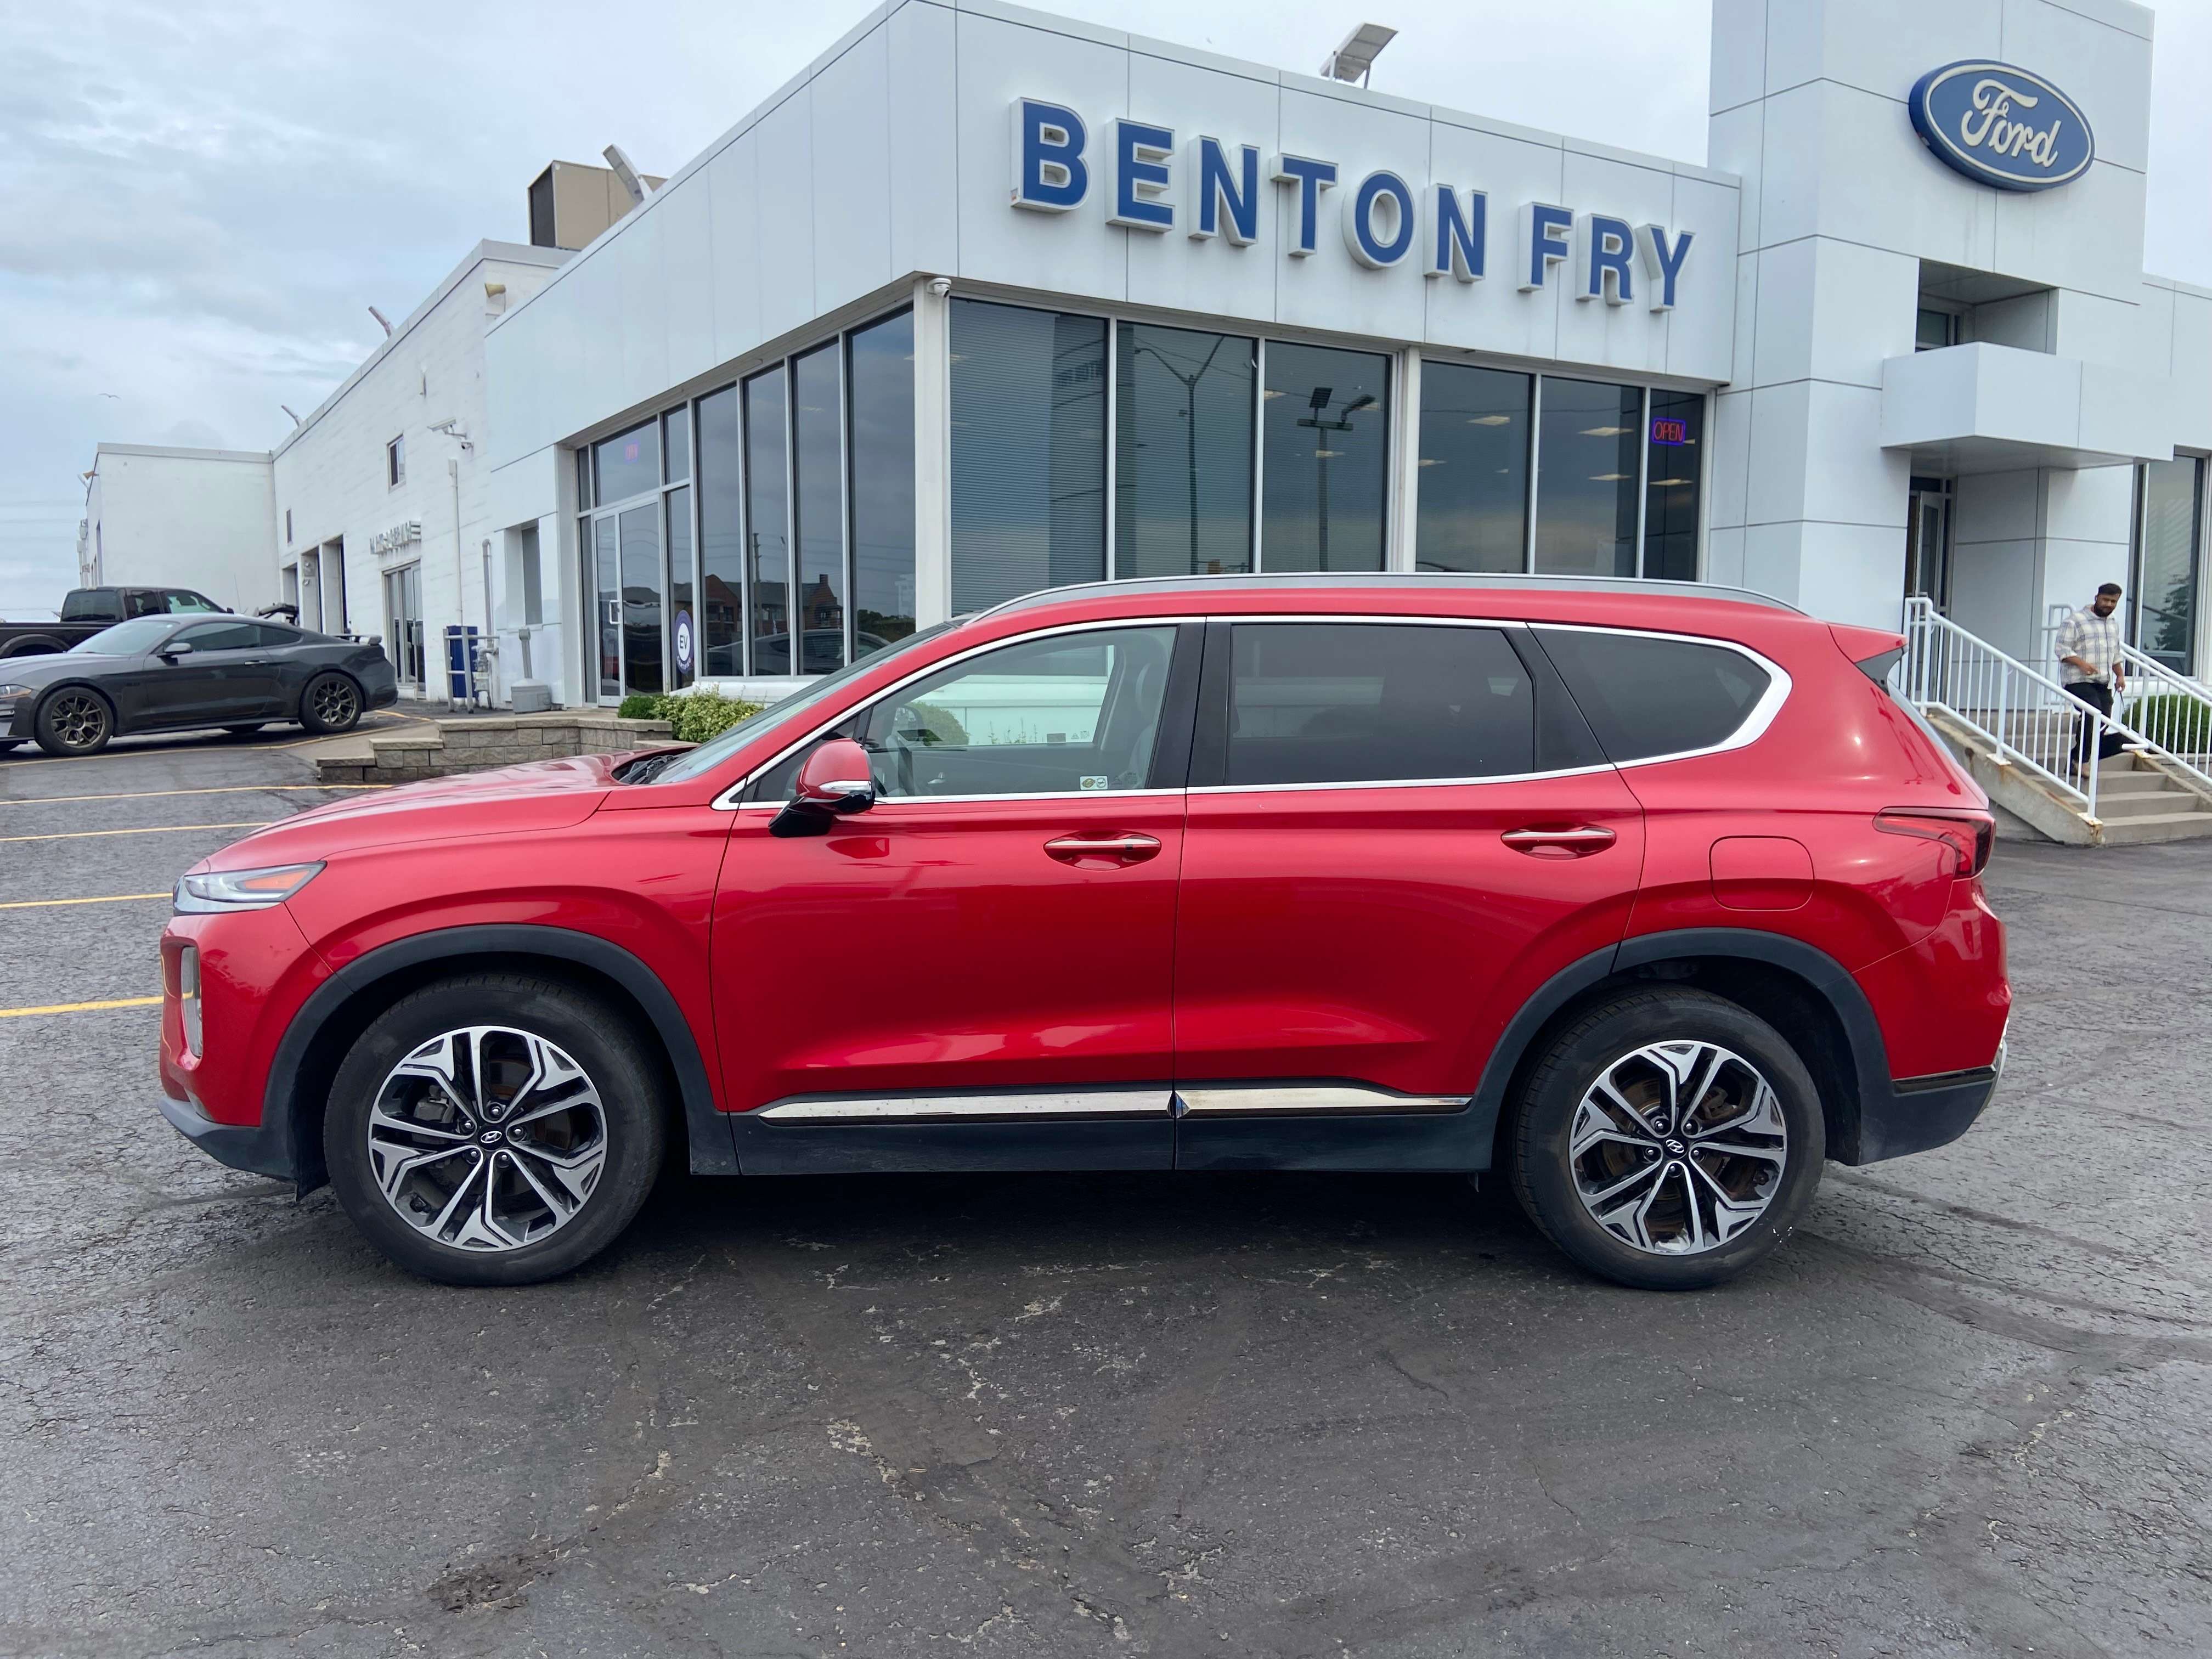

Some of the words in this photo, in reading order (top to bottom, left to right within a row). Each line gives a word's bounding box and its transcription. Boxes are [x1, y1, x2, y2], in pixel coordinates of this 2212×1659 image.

[1960, 78, 2062, 168] Ford
[1012, 98, 1488, 281] BENTON
[1520, 202, 1696, 311] FRY
[1654, 421, 1684, 443] OPEN
[680, 635, 688, 650] EV
